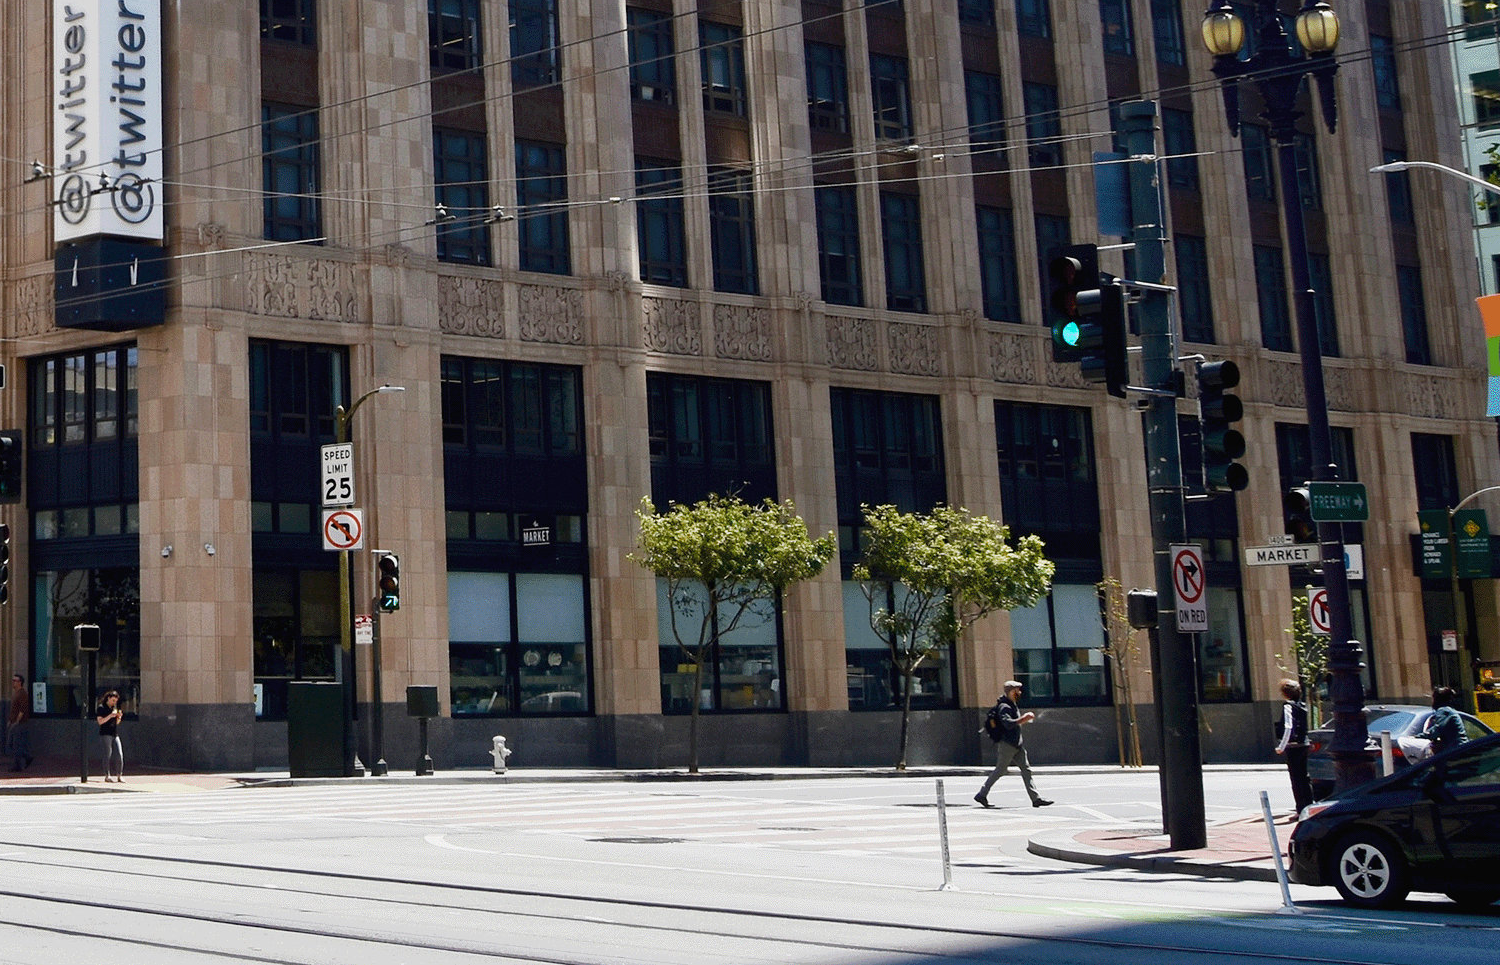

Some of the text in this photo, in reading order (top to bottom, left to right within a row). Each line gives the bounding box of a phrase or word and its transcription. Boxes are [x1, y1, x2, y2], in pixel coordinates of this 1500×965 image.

[59, 5, 91, 225] @twitter
[110, 0, 154, 224] @twitter
[324, 450, 351, 461] SPEED
[327, 463, 348, 474] LIMIT
[325, 477, 351, 500] 25
[1313, 495, 1351, 509] FREEWAY
[523, 530, 550, 543] MARKET
[1257, 549, 1309, 562] MARKET
[1180, 609, 1206, 623] ON RED
